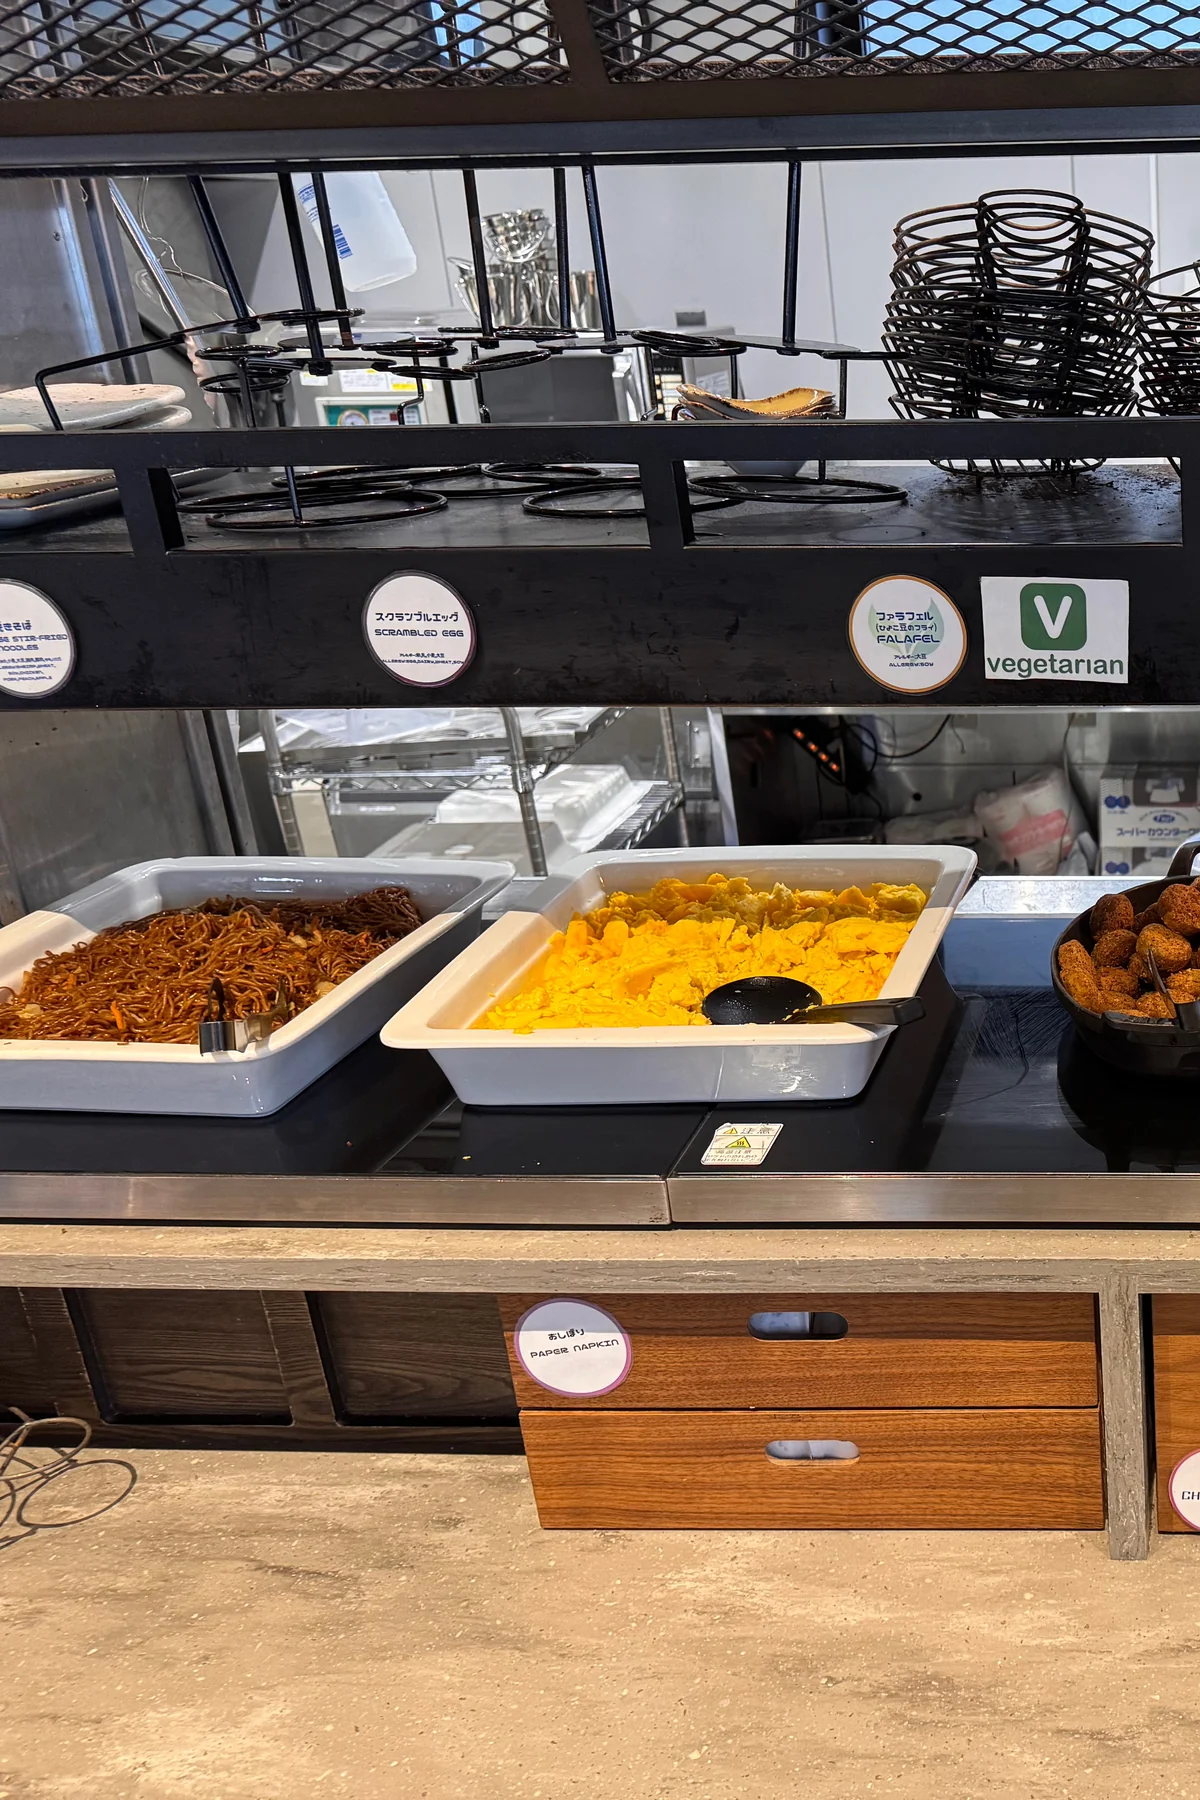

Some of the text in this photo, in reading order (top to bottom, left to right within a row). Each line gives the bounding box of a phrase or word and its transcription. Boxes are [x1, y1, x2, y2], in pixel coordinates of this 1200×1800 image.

[375, 611, 459, 622] スクランブルエッグ
[876, 611, 934, 621] ファラフェル
[1033, 595, 1073, 639] V
[12, 633, 68, 642] STIR-FRIED
[374, 629, 464, 637] SCRAMBLED EGG
[876, 634, 941, 644] FALAFEL
[987, 653, 1124, 678] vegetarian
[1116, 827, 1200, 837] スーパーカウンターク
[547, 1328, 585, 1341] おしぼり
[530, 1339, 620, 1358] PAPER NAPKIN
